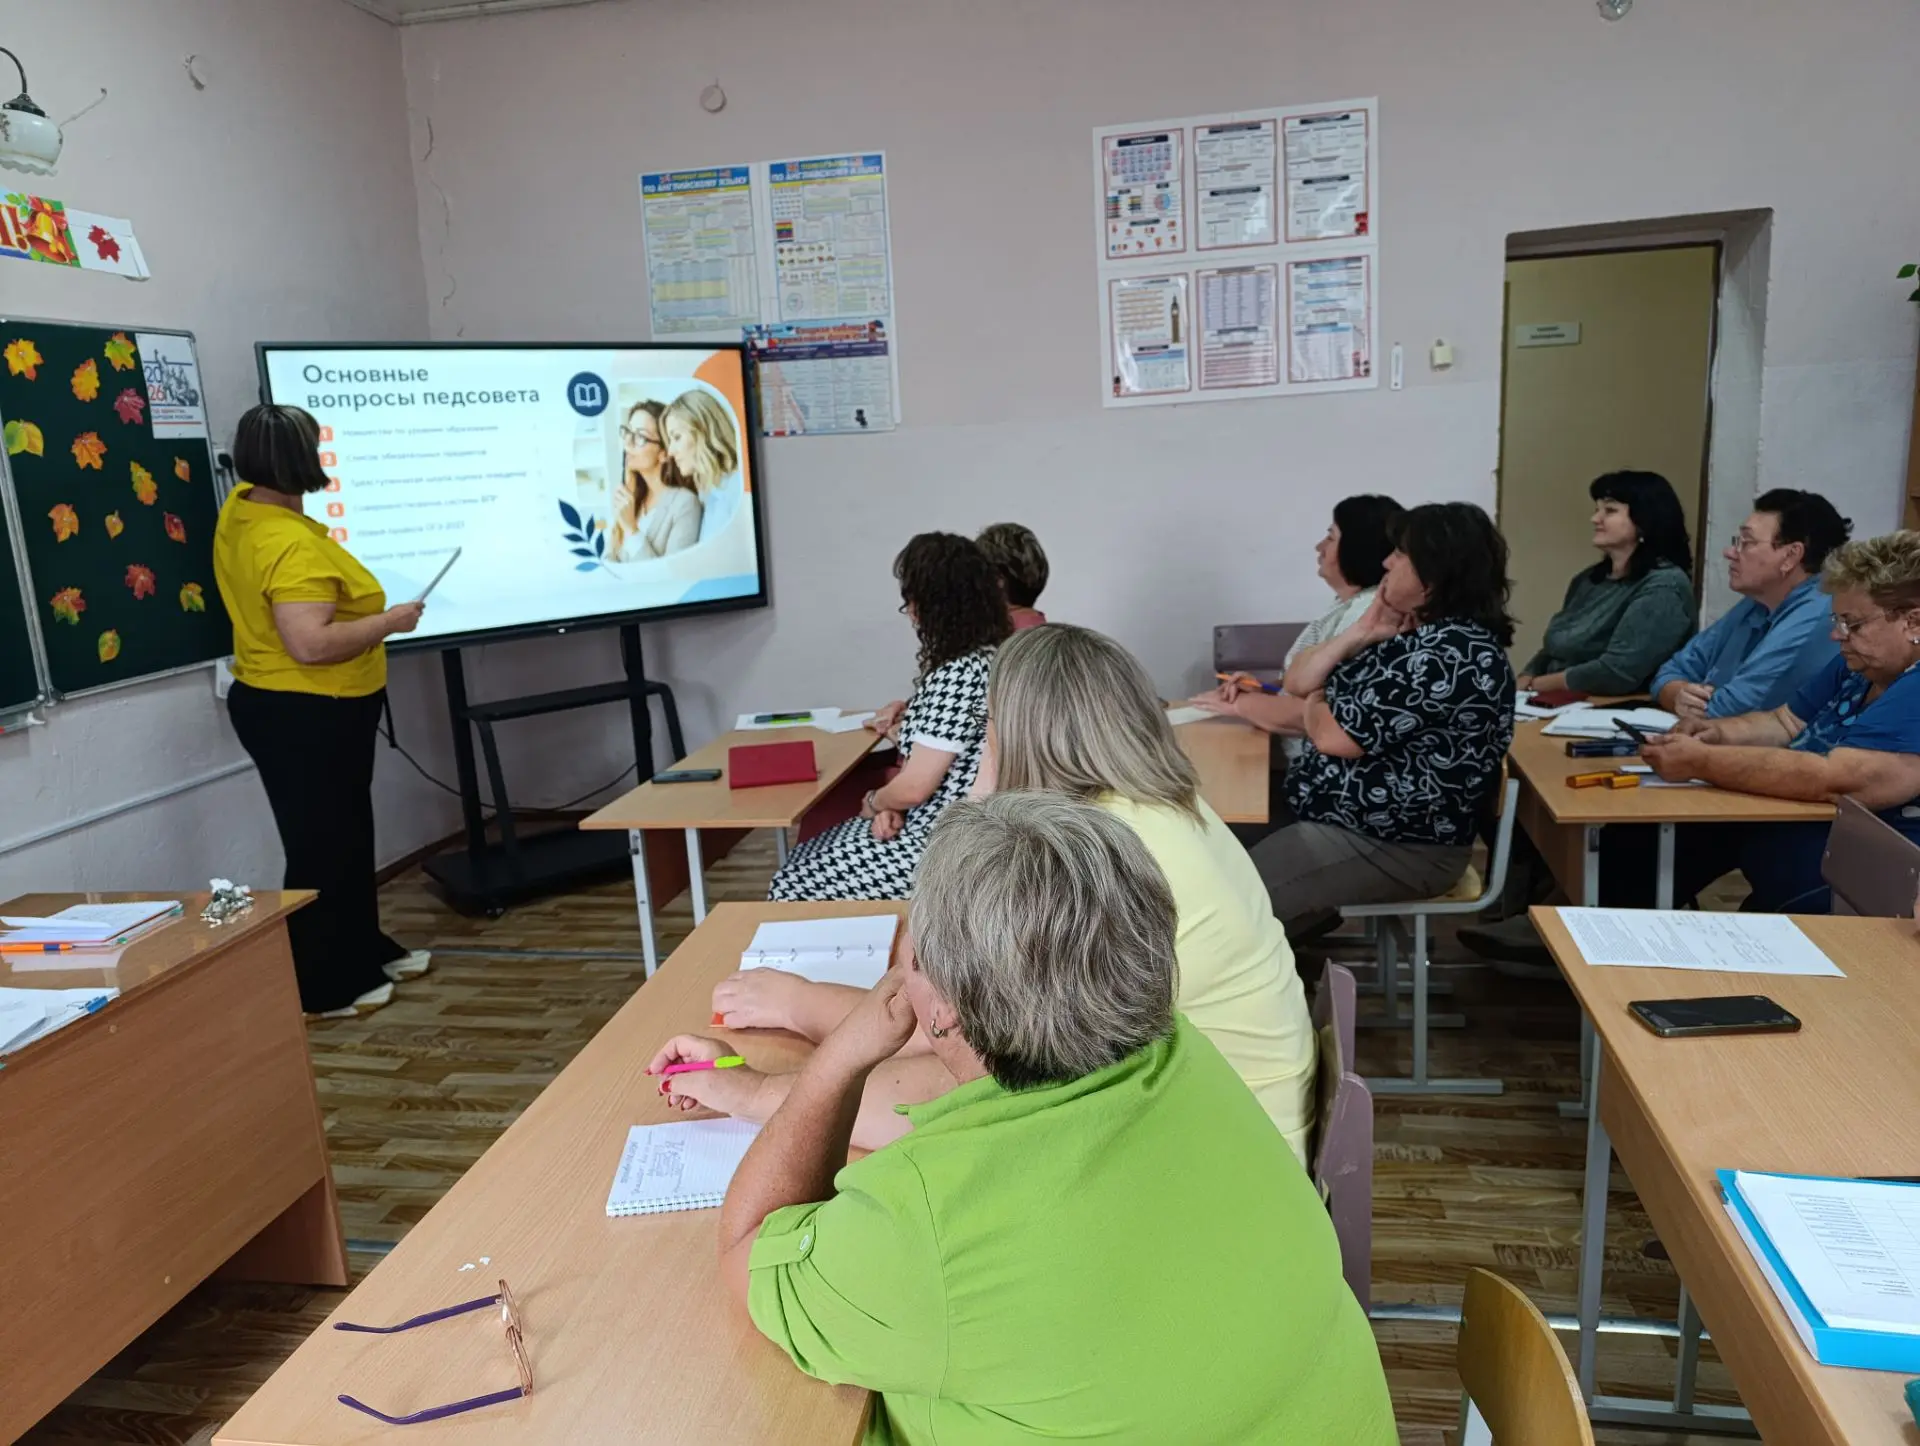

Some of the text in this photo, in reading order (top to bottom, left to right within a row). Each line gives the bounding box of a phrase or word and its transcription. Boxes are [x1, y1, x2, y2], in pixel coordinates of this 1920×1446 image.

[303, 364, 429, 383] Основные
[307, 389, 540, 411] вопросы педсовета
